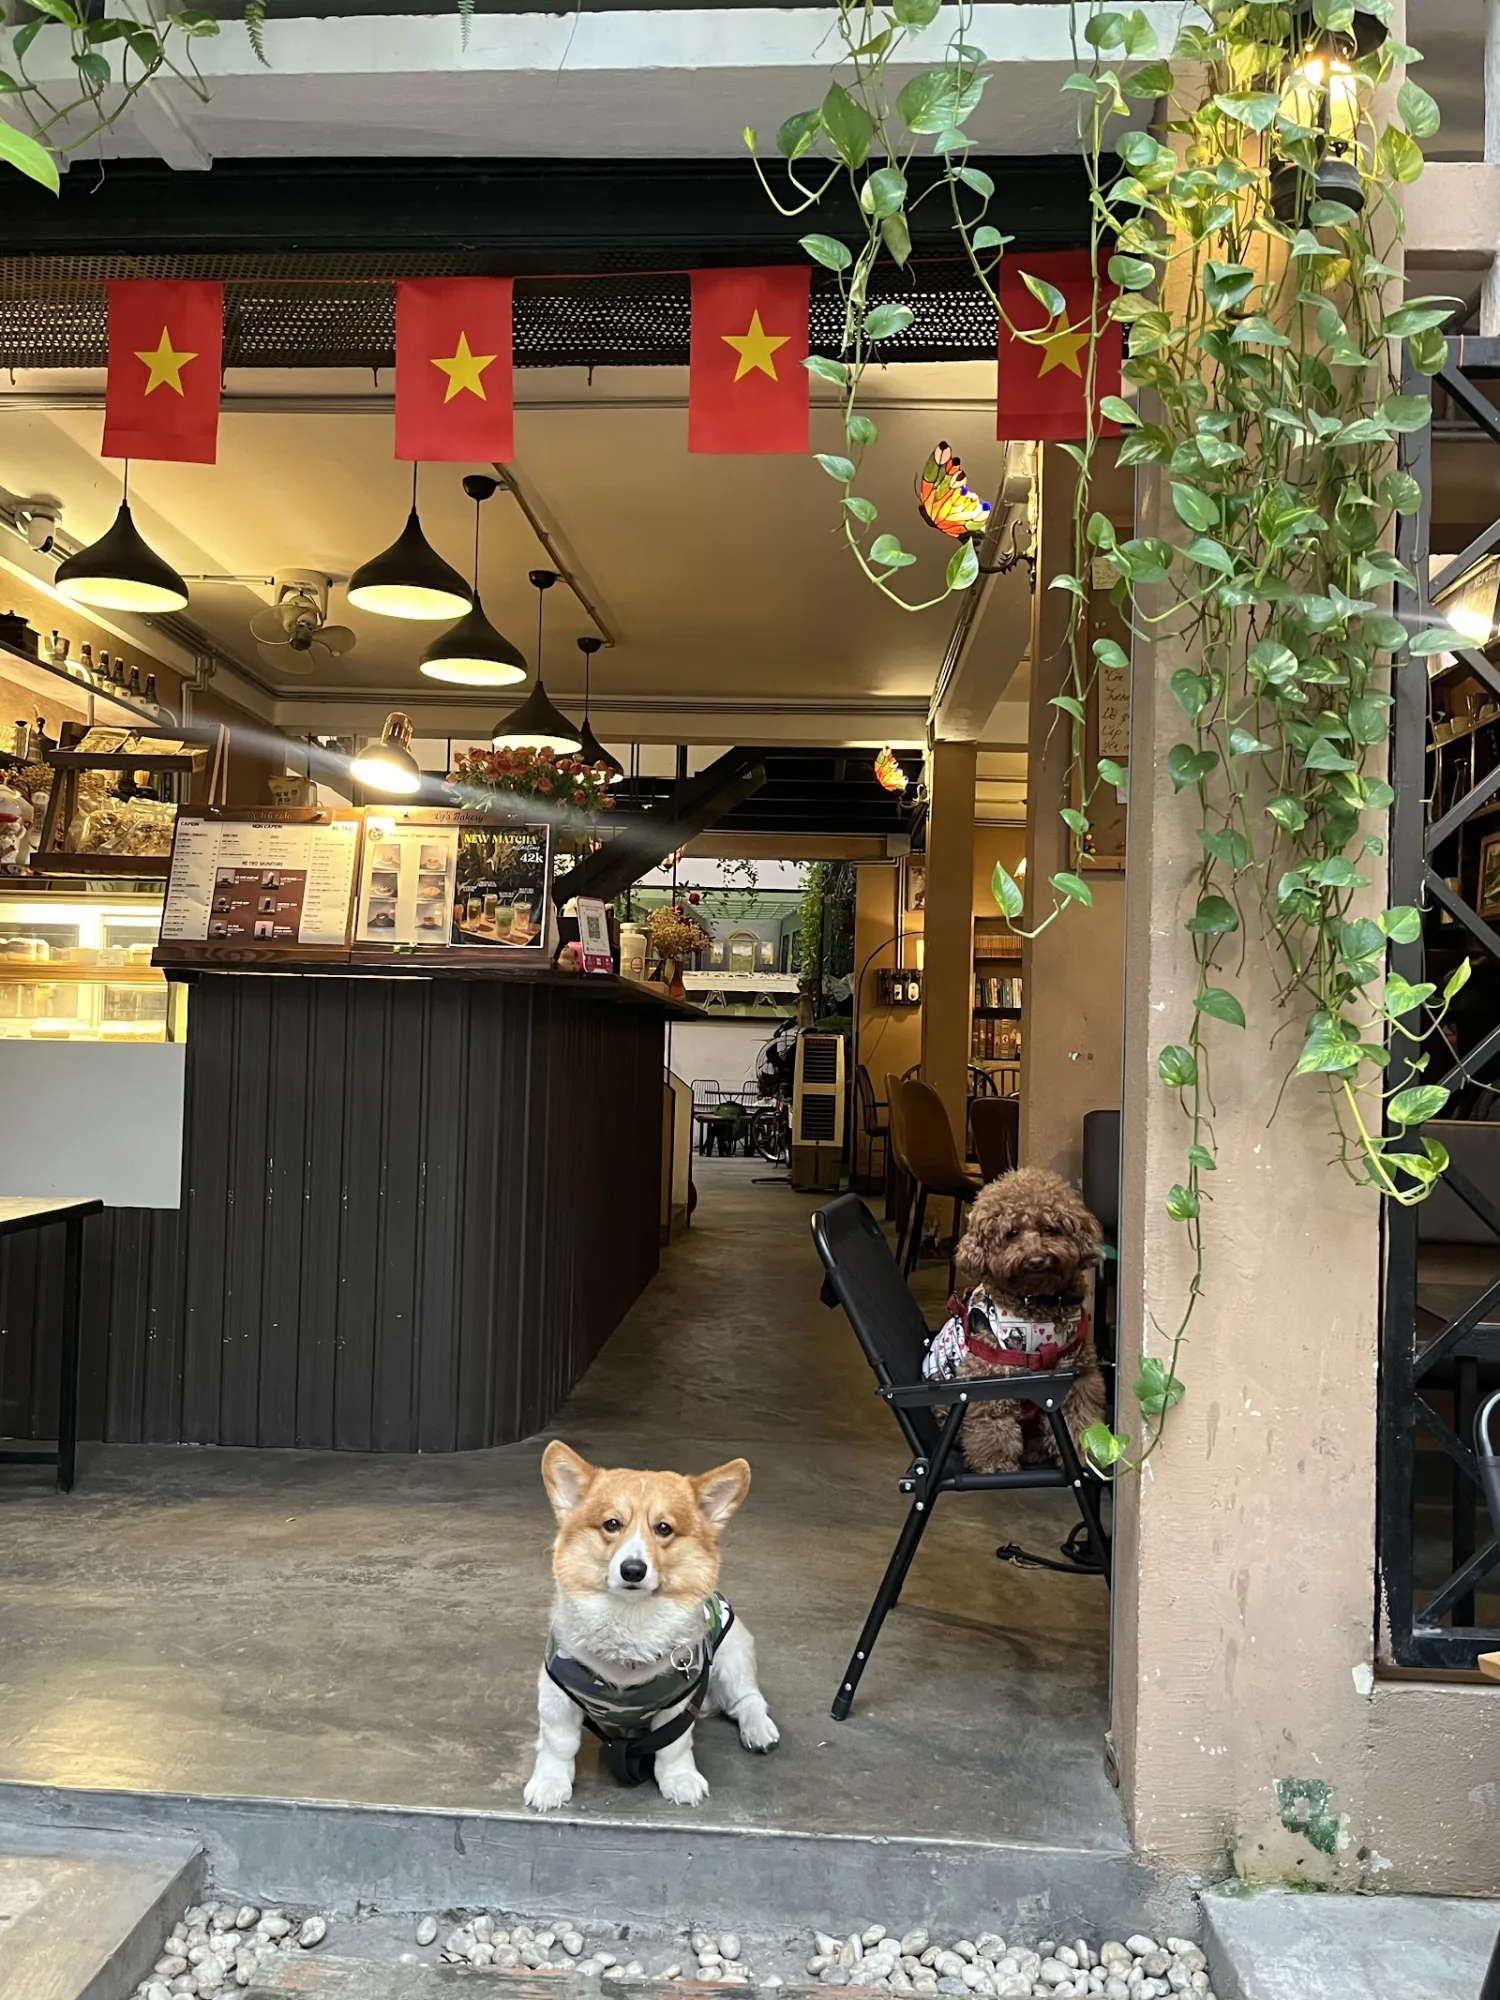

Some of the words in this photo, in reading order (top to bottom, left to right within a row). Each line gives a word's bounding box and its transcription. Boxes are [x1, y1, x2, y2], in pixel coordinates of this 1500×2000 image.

[453, 811, 485, 823] Bakery
[464, 833, 490, 844] NEW
[491, 834, 537, 845] MATCHA
[519, 852, 544, 863] 42k
